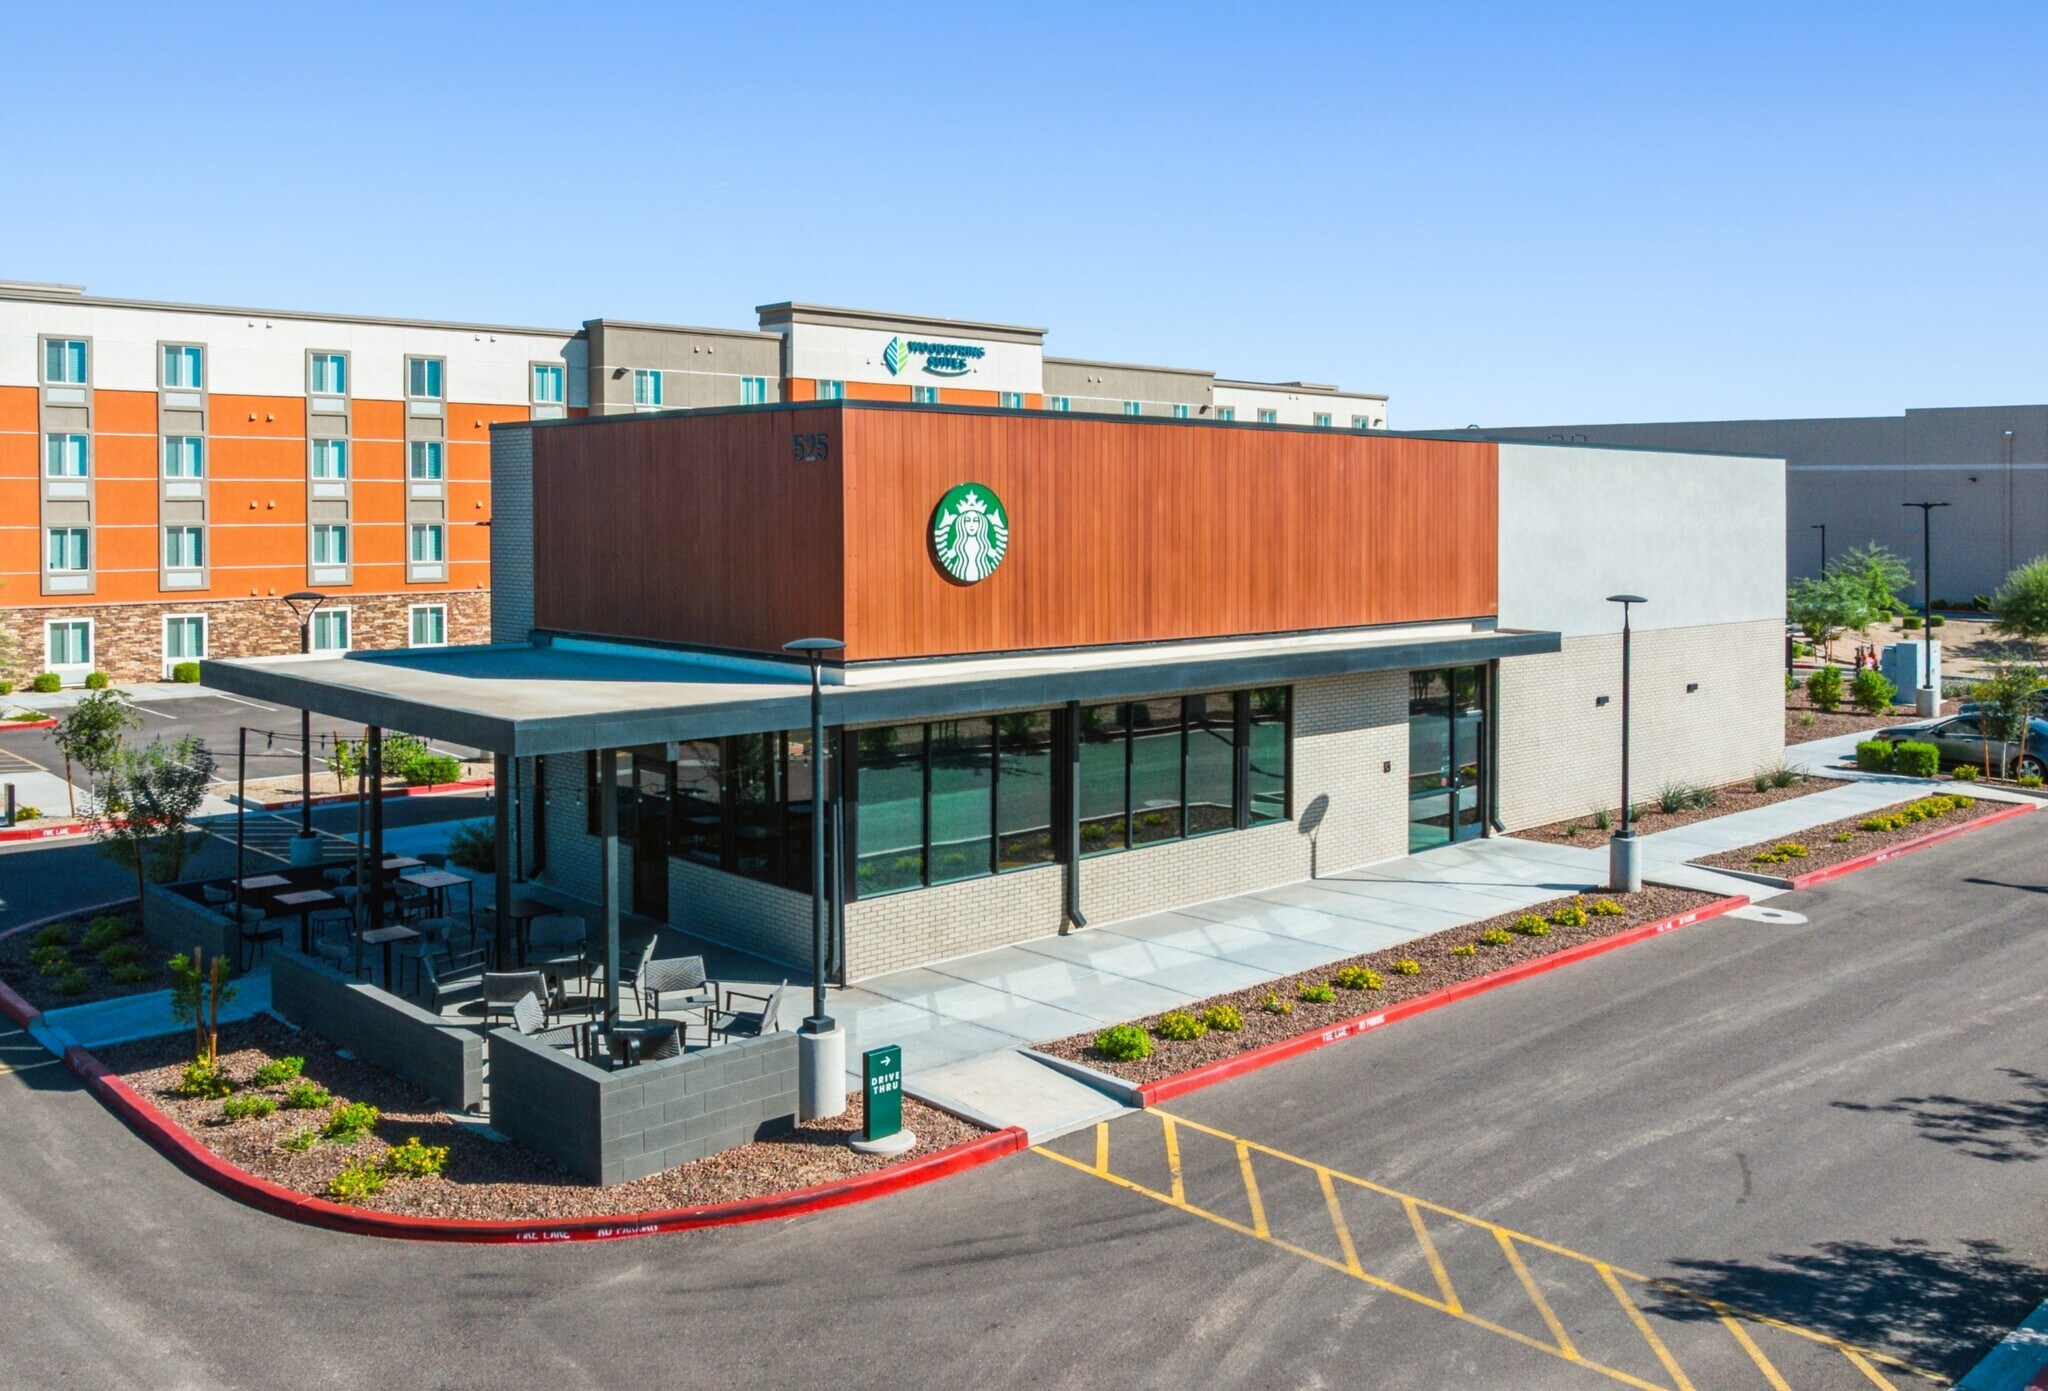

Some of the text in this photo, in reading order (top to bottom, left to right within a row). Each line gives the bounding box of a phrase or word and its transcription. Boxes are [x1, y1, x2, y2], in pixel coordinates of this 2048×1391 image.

[907, 341, 985, 359] WOODSPRING
[926, 356, 967, 370] SUITES
[793, 434, 828, 461] 525
[871, 1071, 900, 1087] DRIVE
[873, 1081, 899, 1095] THRU
